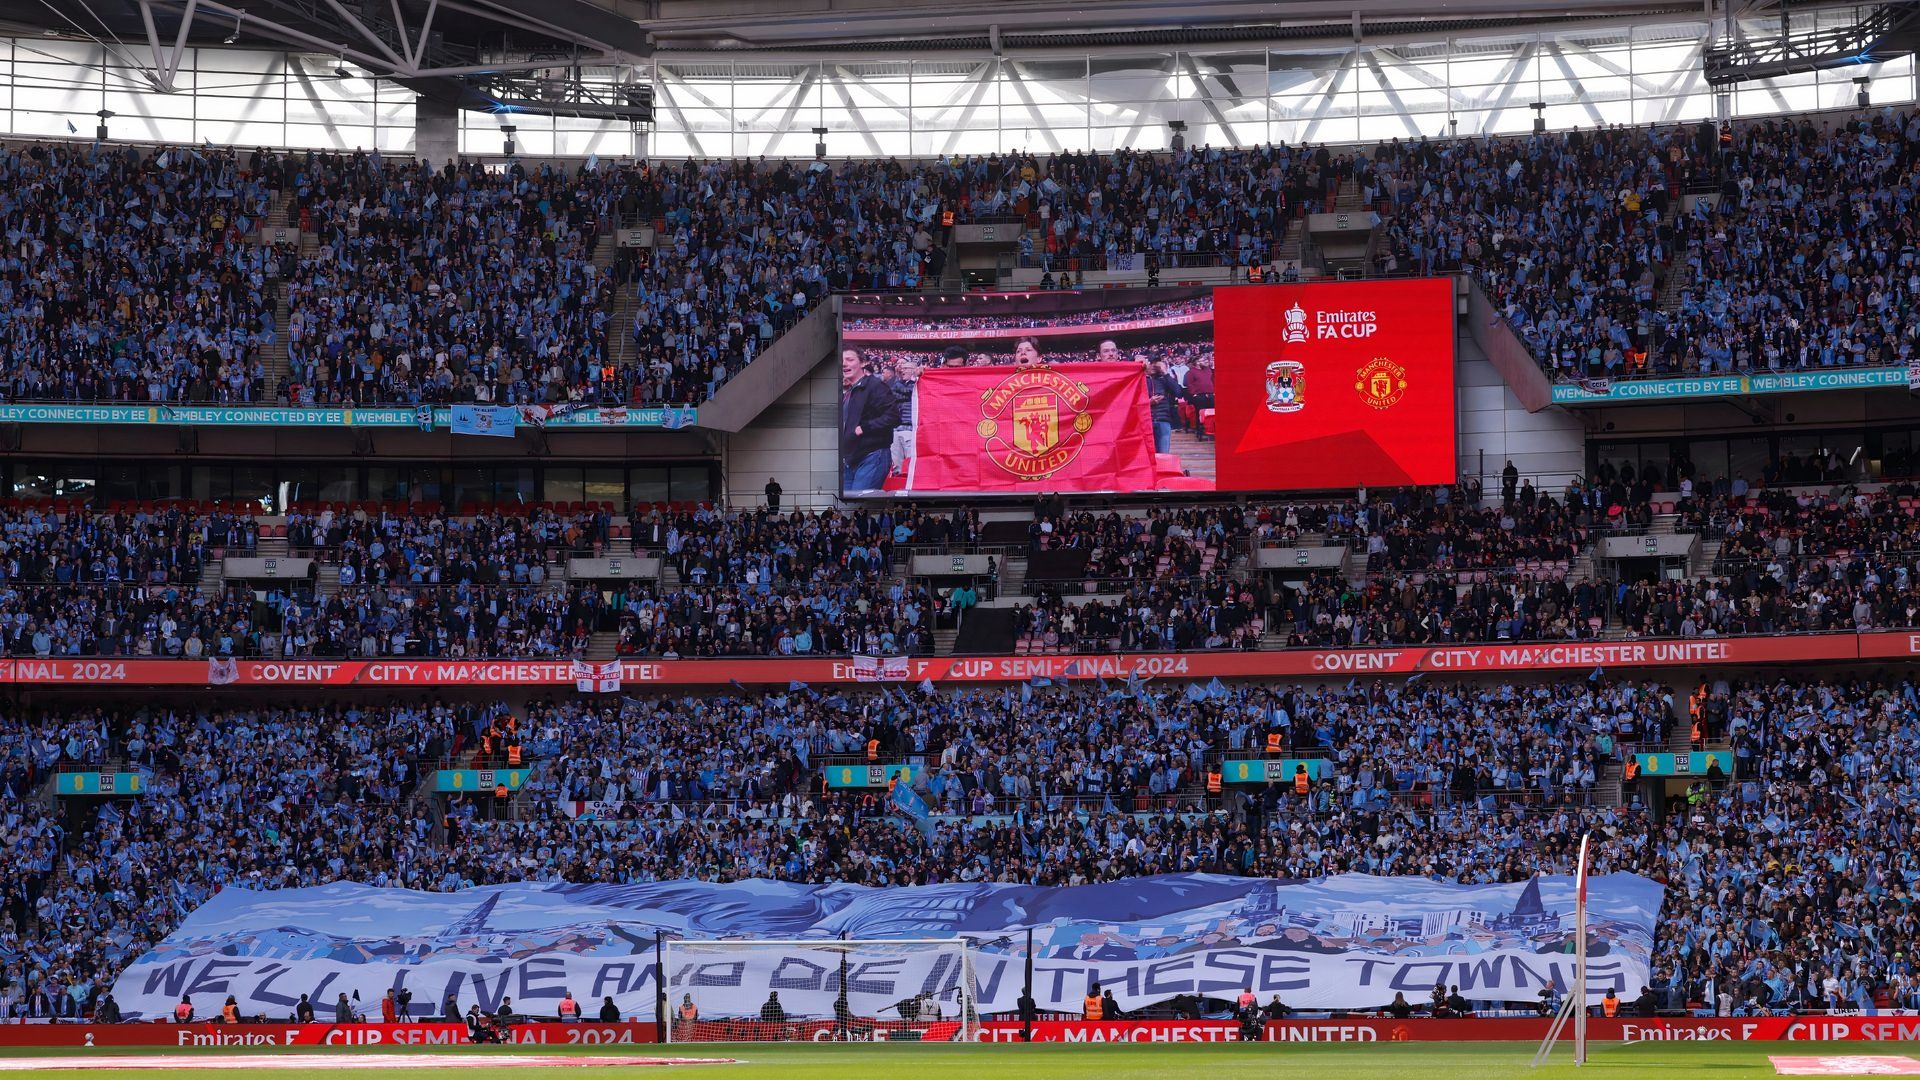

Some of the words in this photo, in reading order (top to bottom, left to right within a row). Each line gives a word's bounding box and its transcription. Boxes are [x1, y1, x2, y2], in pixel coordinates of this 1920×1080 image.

[1316, 310, 1376, 324] Emirates
[1317, 325, 1338, 340] FA
[1341, 323, 1377, 338] CUP
[1359, 358, 1402, 378] MANCHESTER
[1619, 382, 1700, 395] CONNECTED
[1703, 381, 1721, 392] BY
[1723, 380, 1738, 391] EE
[1753, 376, 1816, 389] WEMBLEY
[1819, 371, 1902, 385] CONNECTED
[989, 371, 1083, 411] MANCHESTER
[1367, 396, 1397, 406] UNITED
[0, 408, 26, 419] LEY
[28, 408, 109, 420] CONNECTED
[112, 409, 128, 420] BY
[131, 410, 145, 420] EE
[161, 410, 222, 421] WEMBLEY
[225, 411, 305, 422] CONNECTED
[307, 412, 325, 422] BY
[327, 412, 341, 422] EE
[355, 412, 417, 423] WEMBLEY
[551, 412, 601, 423] WEMBLE
[1004, 449, 1069, 473] UNITED
[1312, 652, 1403, 671] COVENT
[1430, 650, 1481, 668] CITY
[1485, 655, 1495, 666] v
[1500, 645, 1646, 665] MANCHESTER
[1653, 642, 1734, 661] UNITED
[72, 662, 126, 680] 2024
[251, 664, 340, 681] COVENT
[369, 664, 419, 681] CITY
[423, 670, 432, 681] v
[437, 664, 577, 681] MANCHESTER
[620, 665, 666, 681] ITED
[918, 661, 929, 677] F
[950, 660, 994, 678] CUP
[1000, 657, 1128, 677] SEMI-INAL
[1135, 656, 1189, 675] 2024
[1268, 763, 1280, 771] 134
[393, 958, 568, 1016] LIVE
[591, 961, 746, 998] AND
[768, 956, 907, 995] DIE
[919, 953, 1008, 1004] IN
[1033, 948, 1311, 1003] THESE
[1345, 954, 1626, 996] TOWNS
[177, 1029, 275, 1045] Emirates
[285, 1030, 300, 1045] F
[326, 1029, 383, 1045] CUP
[392, 1028, 548, 1044] SEMI-NAL
[566, 1028, 635, 1044] 2024
[1064, 1027, 1239, 1043] MANCHESTE
[1268, 1026, 1377, 1042] UNITED
[1622, 1023, 1731, 1040] Emiraes
[1743, 1023, 1758, 1040] F
[1787, 1023, 1849, 1040] CUP
